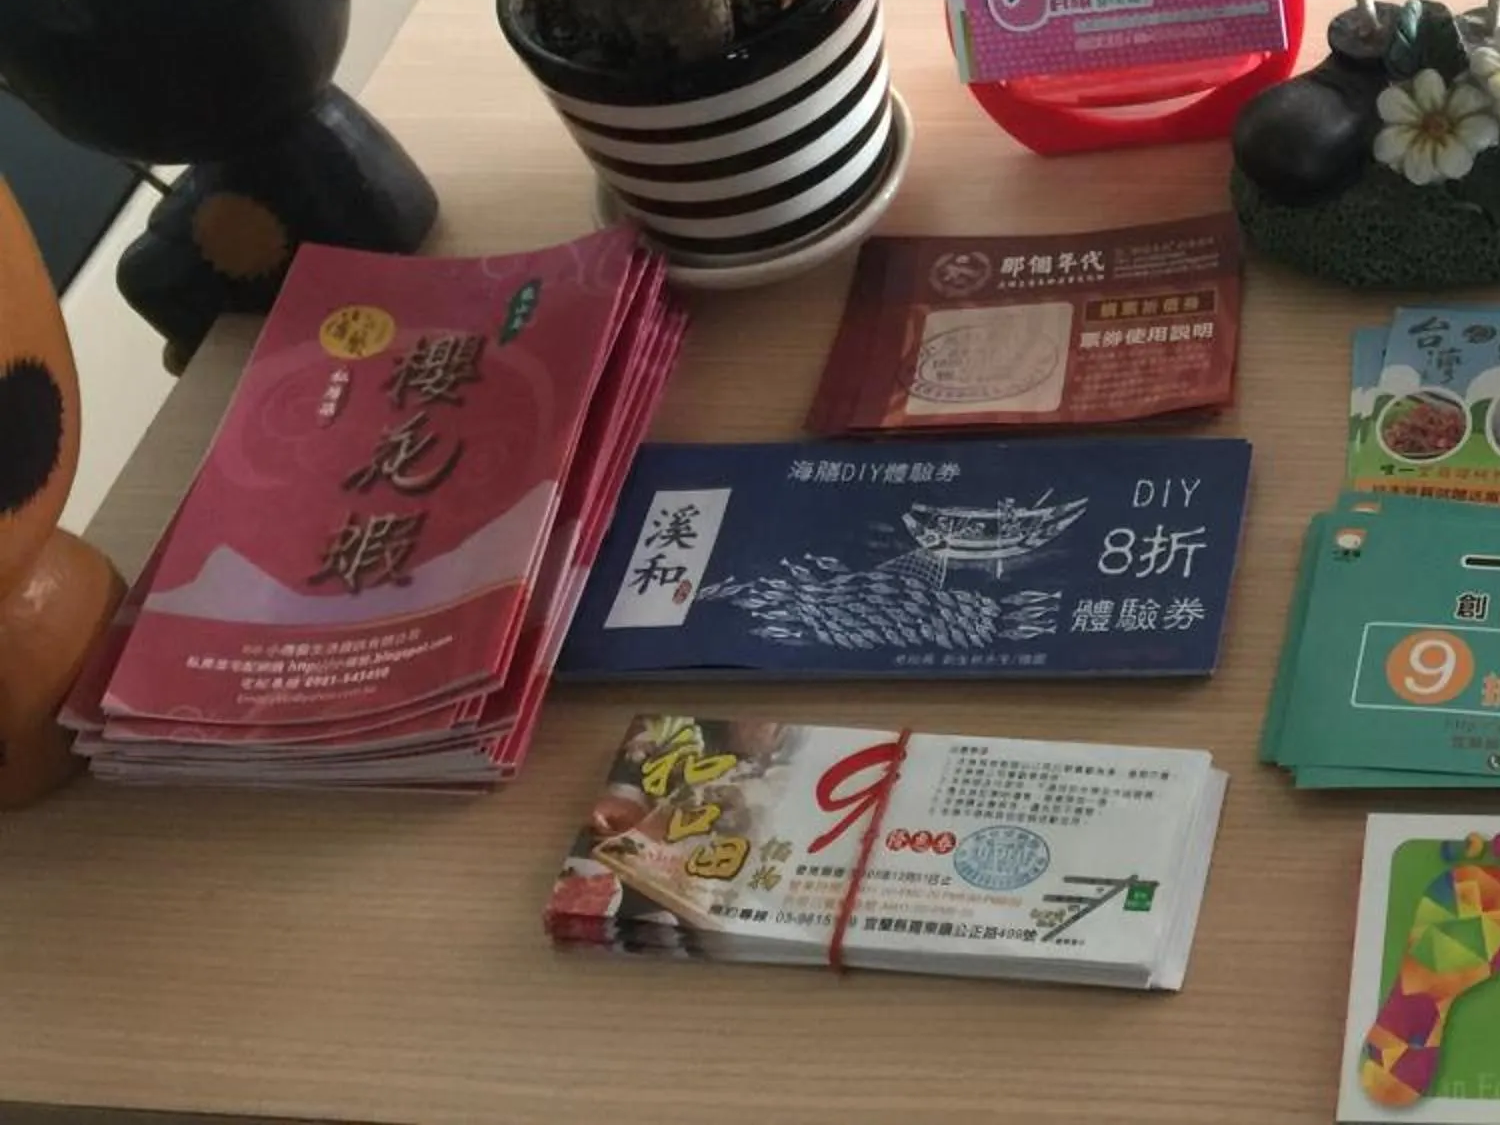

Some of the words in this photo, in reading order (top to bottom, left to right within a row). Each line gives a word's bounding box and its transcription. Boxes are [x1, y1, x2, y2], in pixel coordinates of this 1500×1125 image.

[1000, 250, 1105, 277] 那個年代
[1132, 478, 1202, 509] DIY
[631, 503, 701, 597] 溪和
[1097, 524, 1209, 579] 8折
[1070, 596, 1206, 635] 體驗券
[1404, 638, 1457, 696] 9
[808, 742, 907, 855] 9
